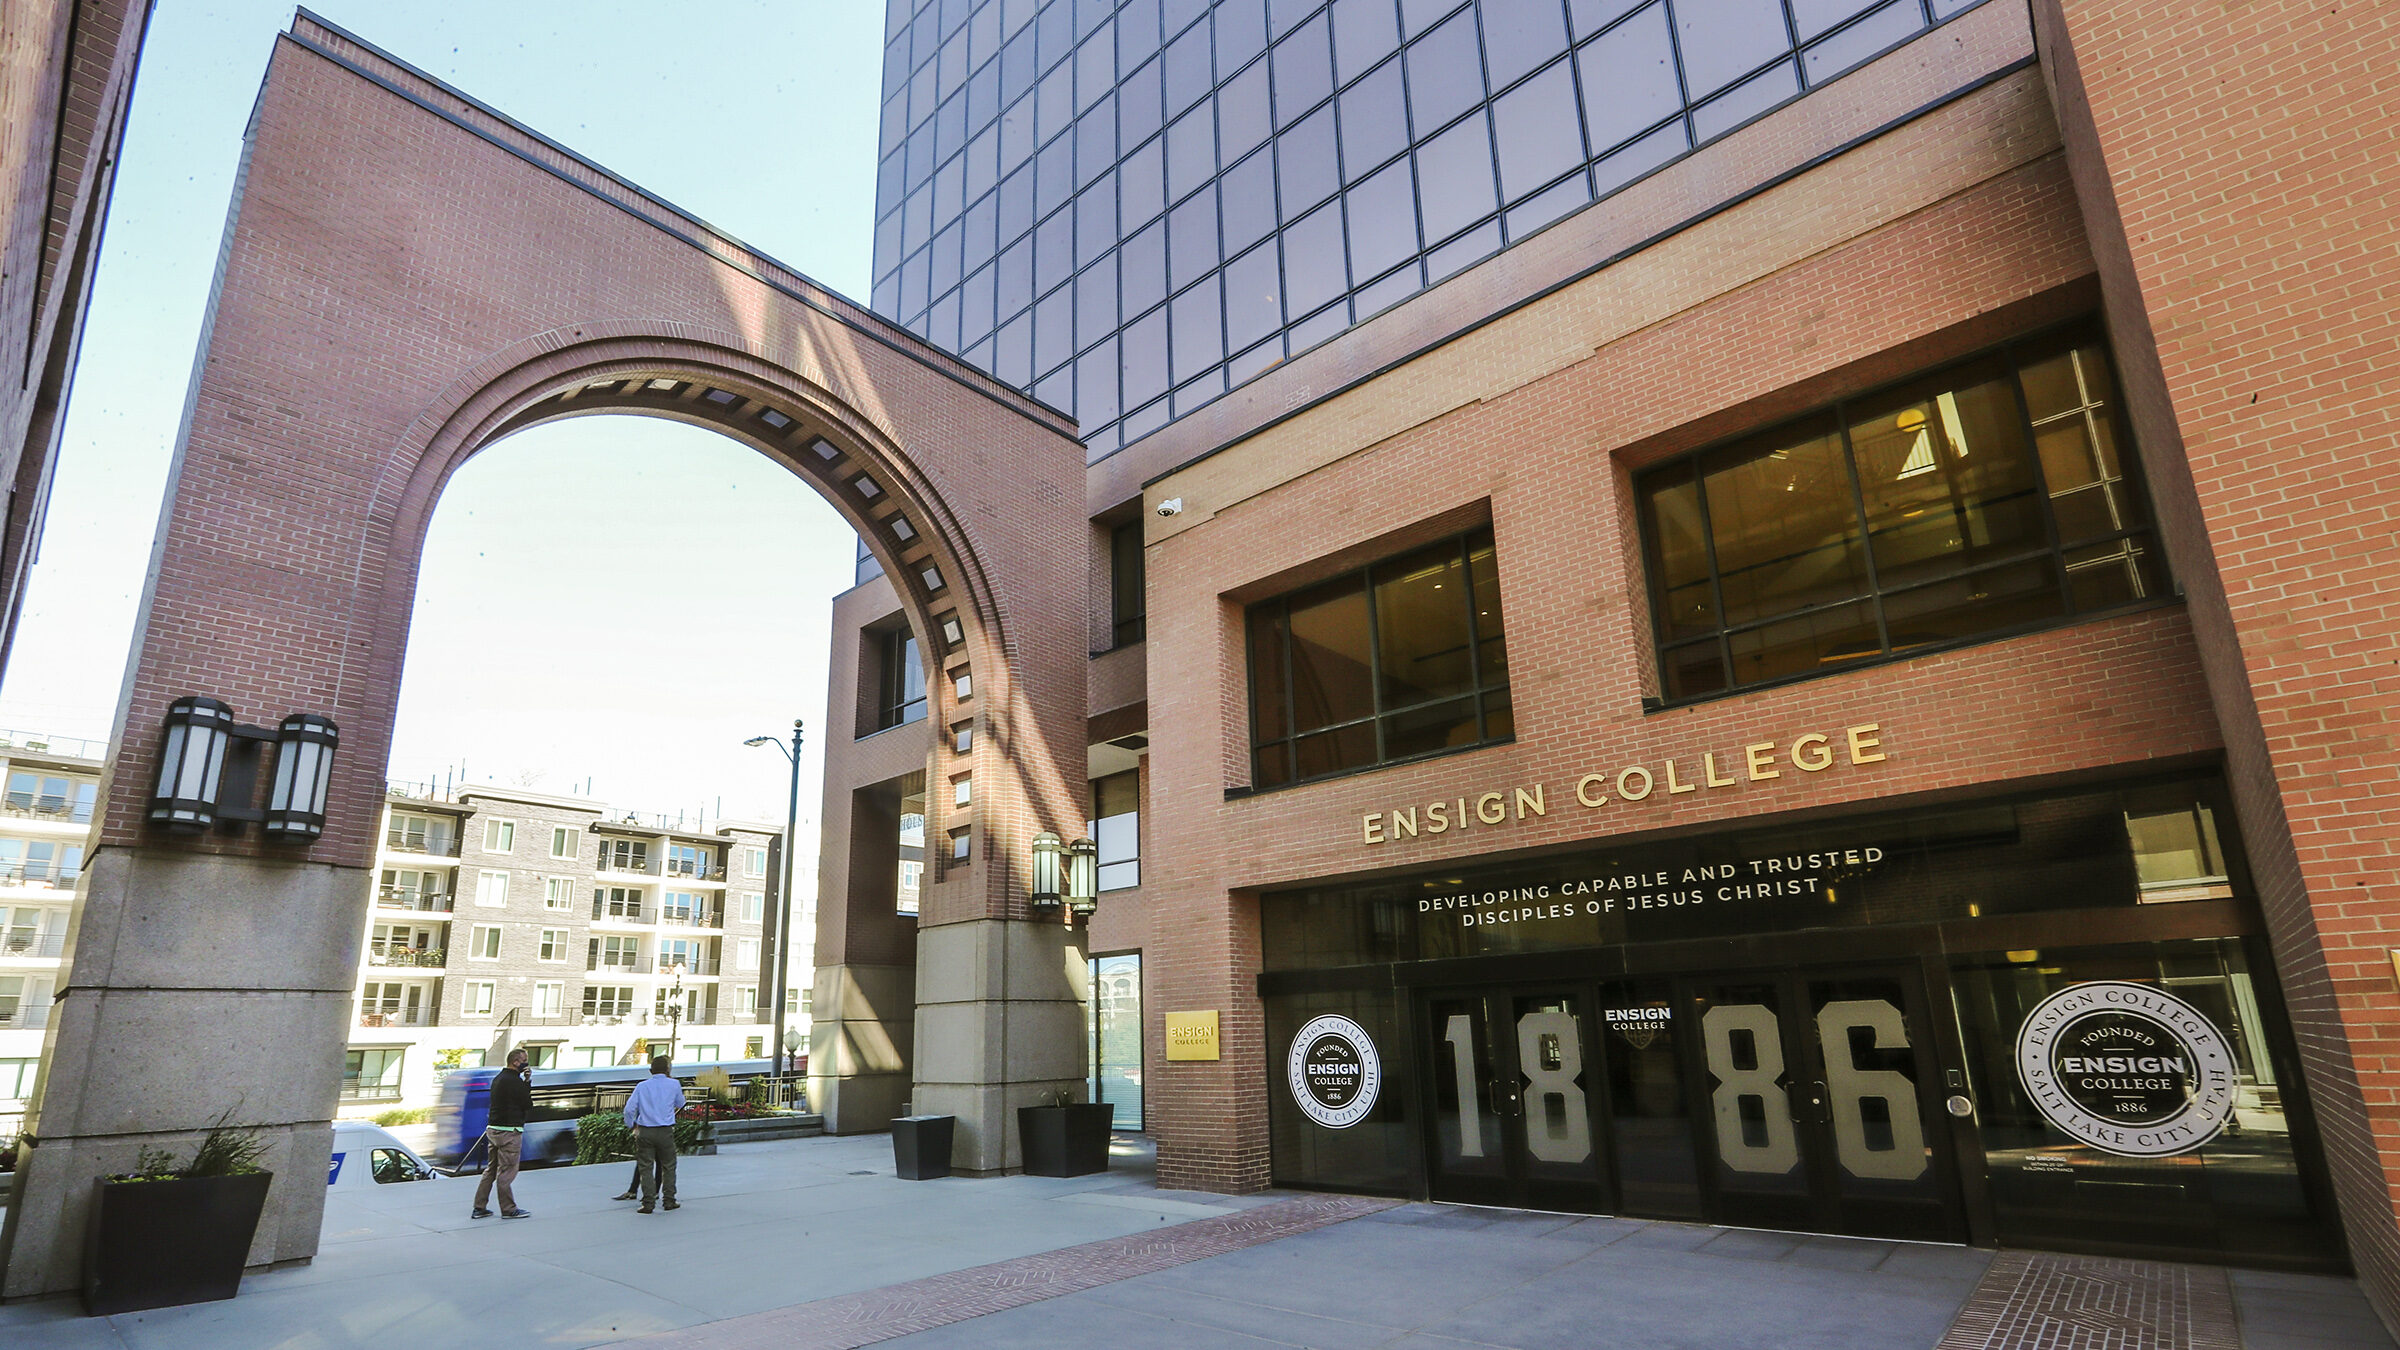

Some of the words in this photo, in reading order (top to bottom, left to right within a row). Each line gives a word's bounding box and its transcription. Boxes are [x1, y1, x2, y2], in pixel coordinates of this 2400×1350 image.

[1363, 783, 1546, 845] ENSIGN
[1576, 722, 1886, 808] COLLEGE
[1418, 885, 1550, 912] DEVELOPING
[1561, 871, 1668, 896] CAPABLE
[1681, 863, 1736, 883] AND
[1749, 847, 1883, 875] TRUSTED
[1462, 903, 1575, 927] DISCIPLES
[1586, 898, 1615, 914] OF
[1626, 890, 1704, 911] JESUS
[1717, 877, 1819, 901] CHRIST
[1604, 1007, 1672, 1021] ENSIGN
[2031, 993, 2094, 1046] ENSIGN
[2105, 990, 2211, 1046] COLLEGE
[1171, 1026, 1213, 1037] ENSIGN
[1612, 1021, 1666, 1031] COLLEGE
[1174, 1038, 1209, 1046] COLLEGE
[1295, 1022, 1325, 1057] ENSIGN
[1329, 1021, 1370, 1054] COLLEGE
[2080, 1027, 2156, 1047] FOUNDED
[1316, 1044, 1349, 1057] FOUNDED
[1308, 1063, 1359, 1075] ENSIGN
[2062, 1056, 2186, 1074] ENSIGN
[1314, 1077, 1353, 1086] COLLEGE
[2081, 1078, 2172, 1091] COLLEGE
[1294, 1072, 1307, 1099] SALT
[1307, 1101, 1331, 1121] LAKE
[1360, 1071, 1375, 1105] UTAH
[1327, 1092, 1342, 1100] 1886
[2031, 1069, 2067, 1111] SALT
[2068, 1114, 2125, 1145] LAKE
[2137, 1122, 2194, 1147] CITY
[2197, 1069, 2226, 1121] UTAH
[2115, 1102, 2149, 1113] 1886
